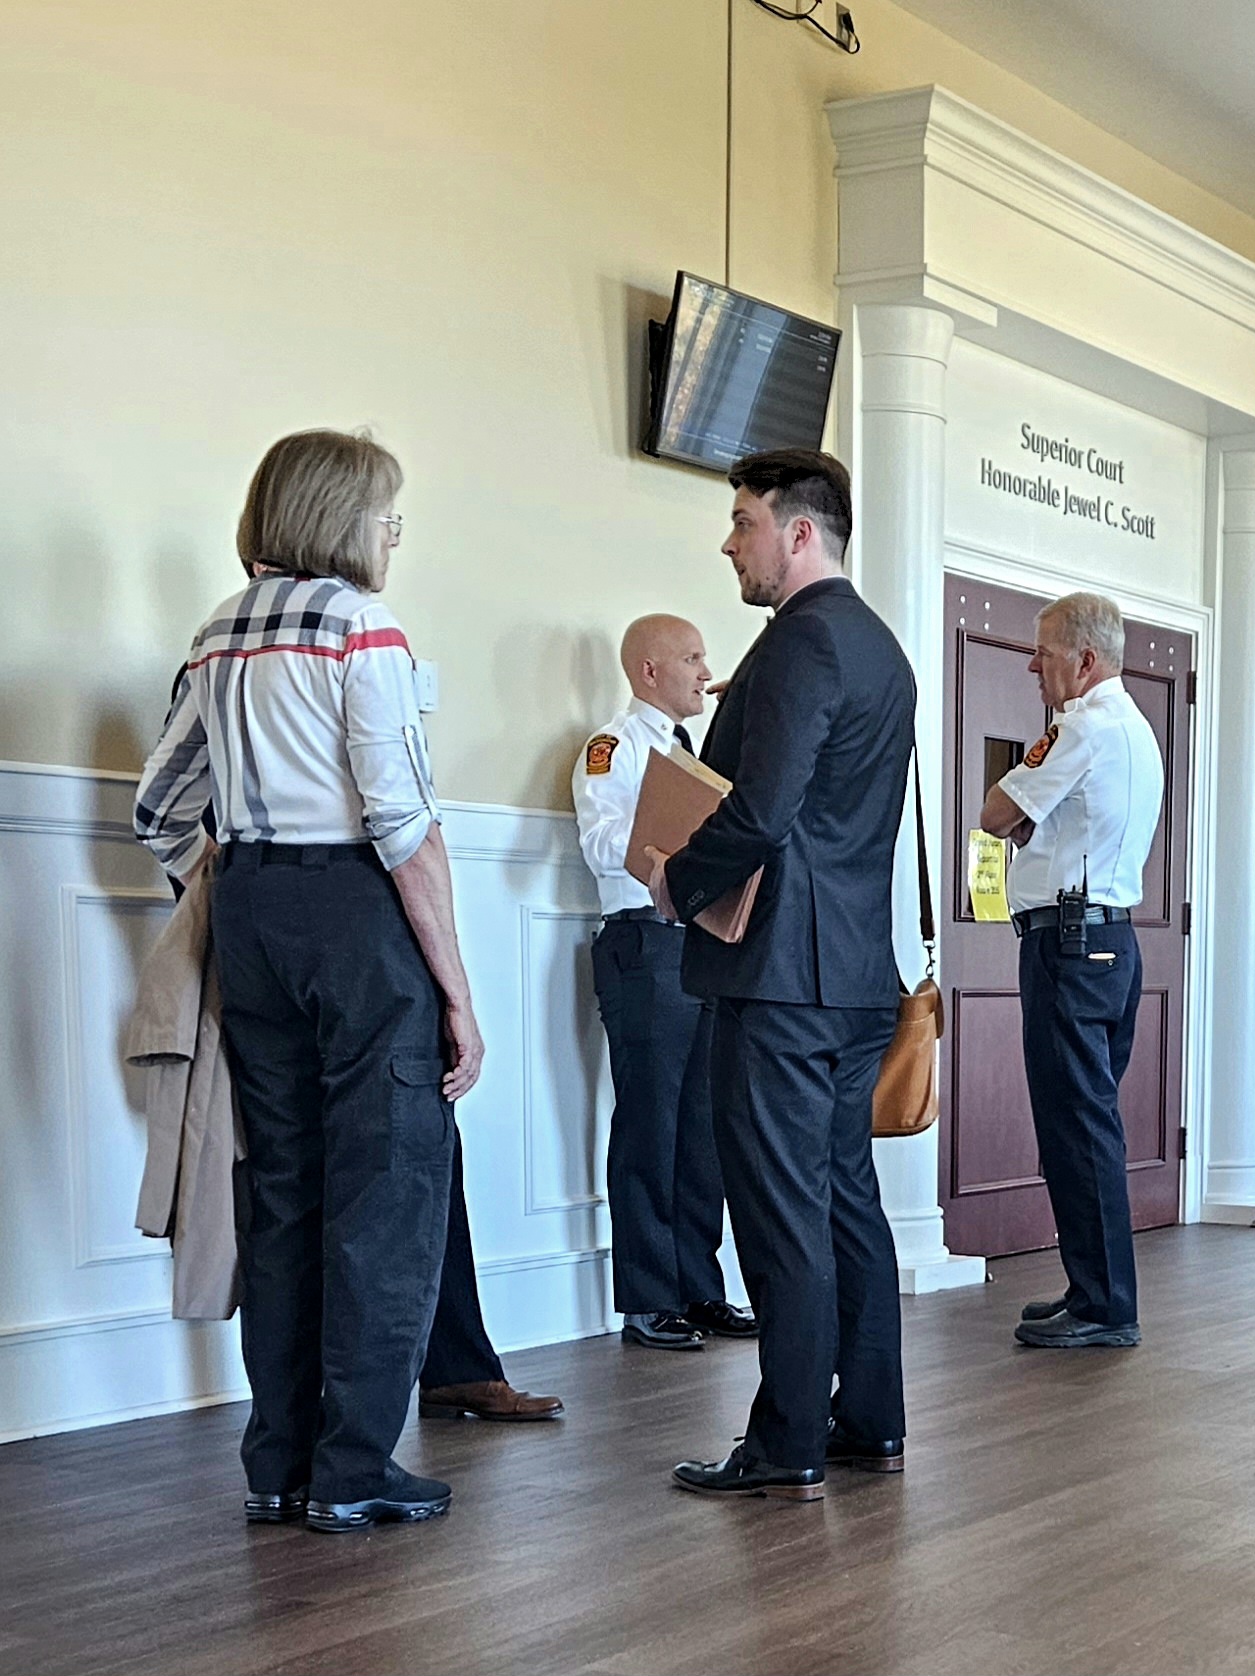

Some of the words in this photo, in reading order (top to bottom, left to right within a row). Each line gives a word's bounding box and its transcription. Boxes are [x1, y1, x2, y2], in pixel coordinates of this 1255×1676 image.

[1021, 422, 1084, 469] Superior
[1086, 447, 1124, 484] Court
[981, 457, 1061, 508] Honorable
[1063, 485, 1101, 522] Jewel
[1104, 500, 1118, 528] C.
[1121, 506, 1155, 540] Scott
